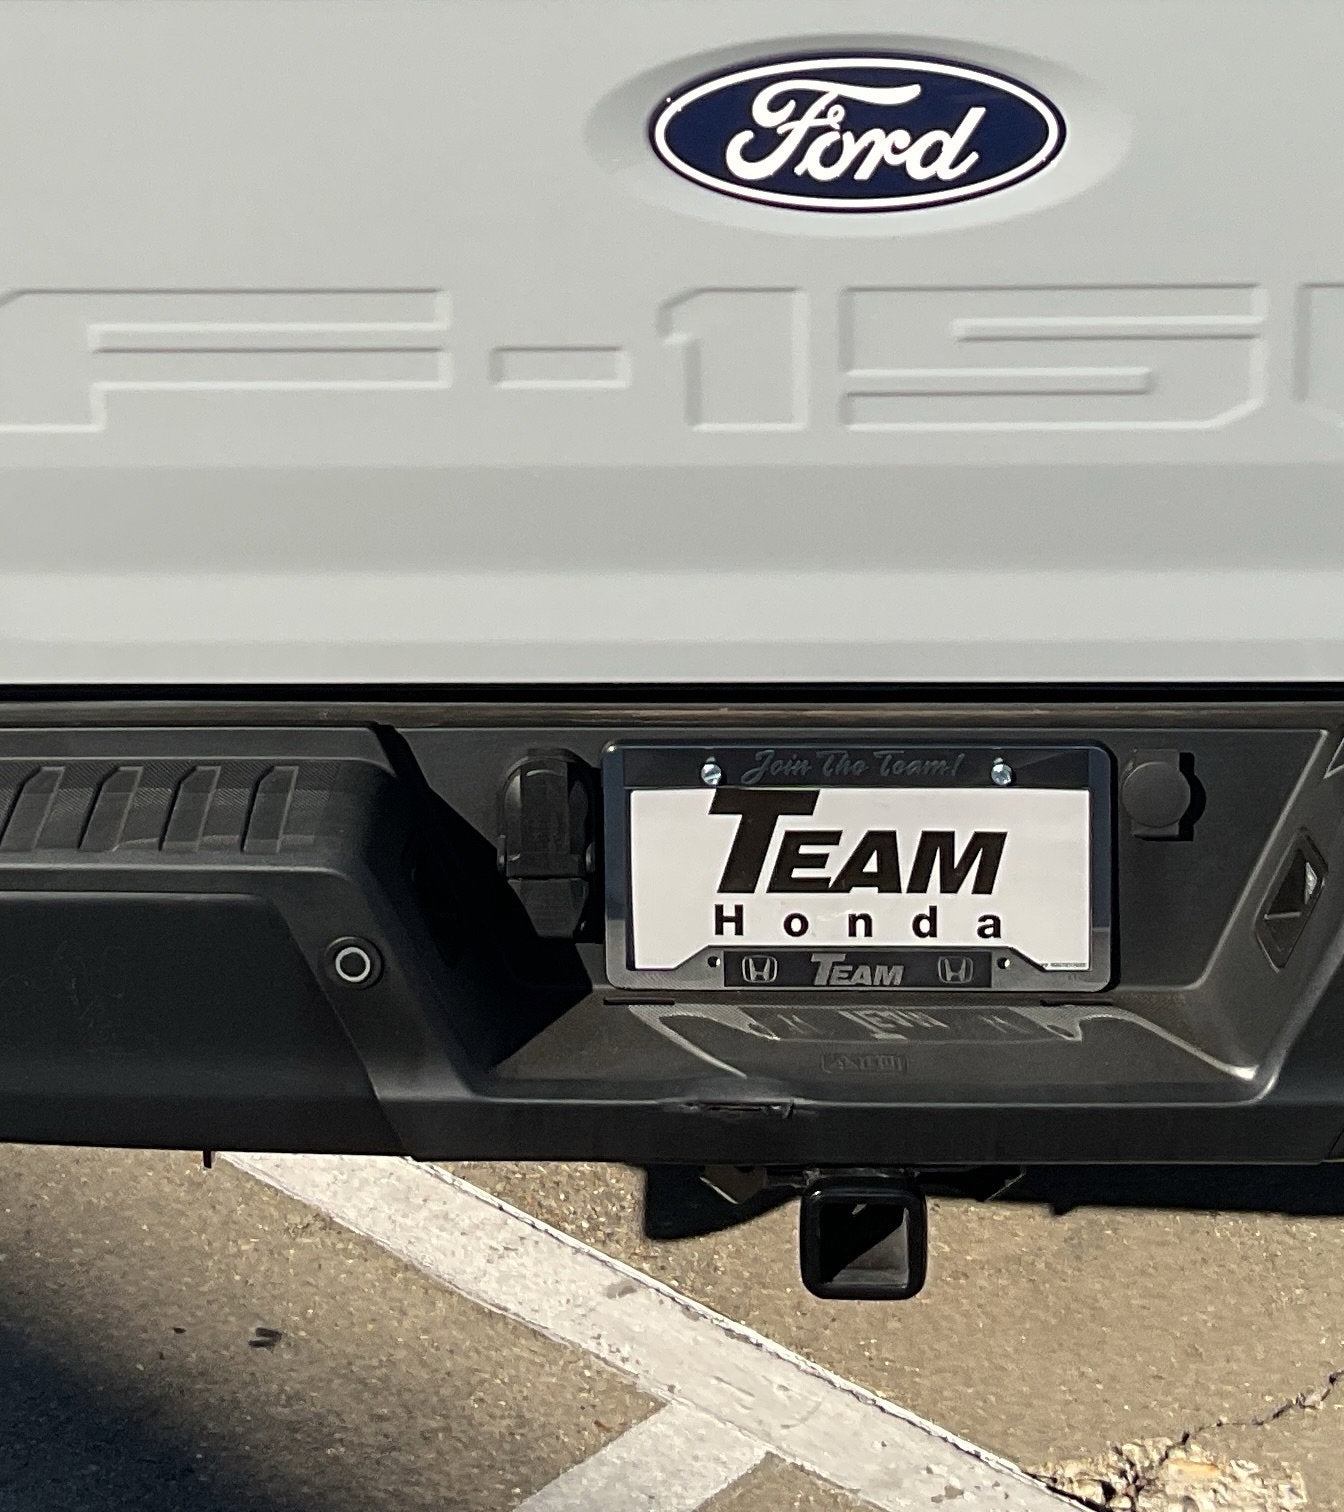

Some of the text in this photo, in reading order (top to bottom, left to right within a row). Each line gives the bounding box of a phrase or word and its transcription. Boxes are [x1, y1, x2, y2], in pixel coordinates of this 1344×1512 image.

[725, 78, 987, 182] Ford
[740, 748, 966, 785] Join The Team!
[708, 788, 1008, 894] TEAM
[714, 904, 1002, 940] Honda
[810, 952, 905, 987] TEAM
